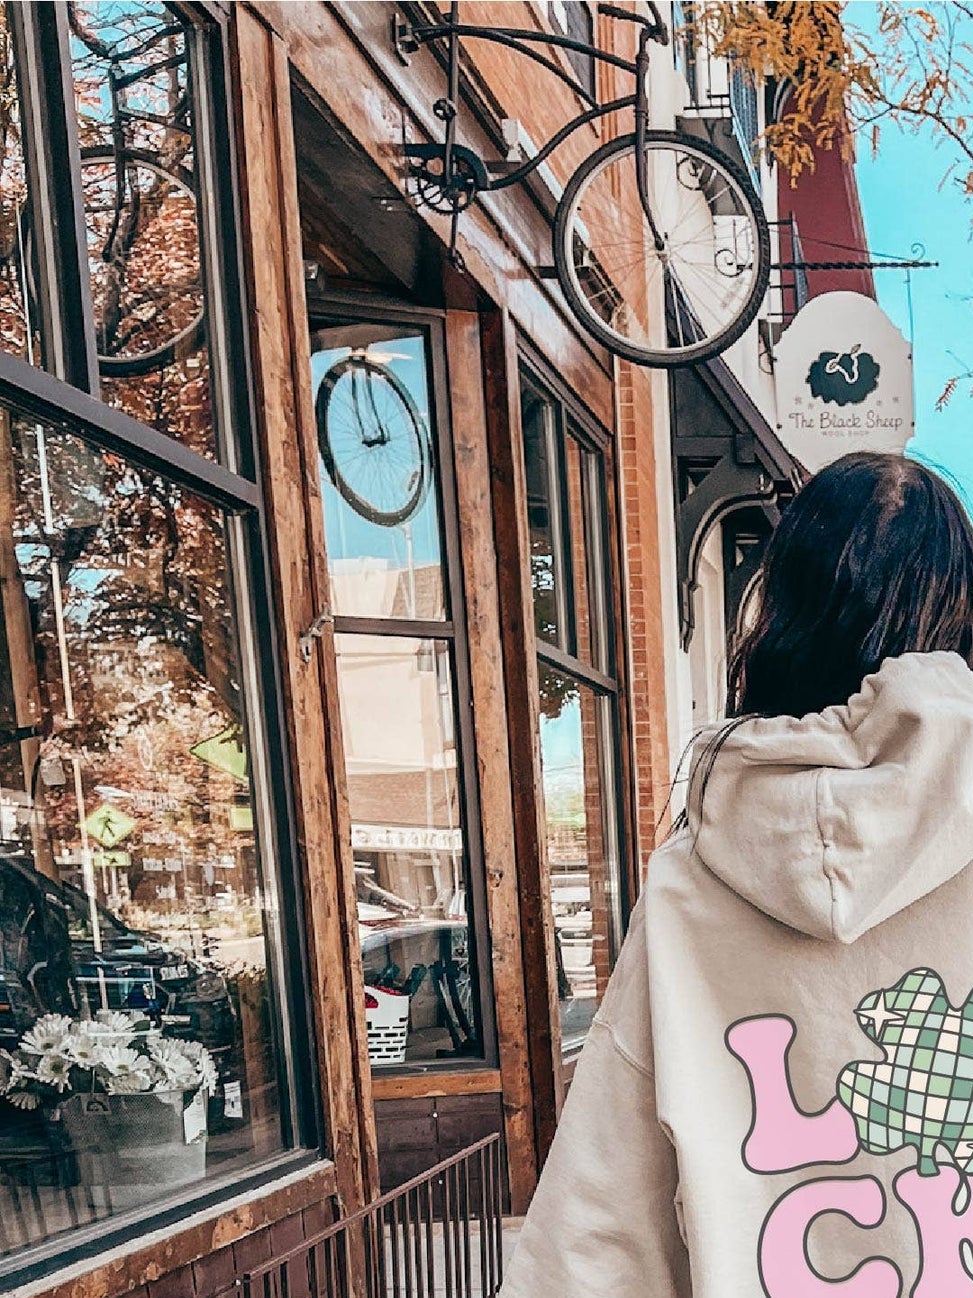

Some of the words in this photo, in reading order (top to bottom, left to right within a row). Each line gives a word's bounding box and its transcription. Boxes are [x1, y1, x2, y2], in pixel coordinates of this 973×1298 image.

[789, 412, 814, 428] The
[820, 411, 861, 428] Black
[866, 409, 903, 430] Sheep
